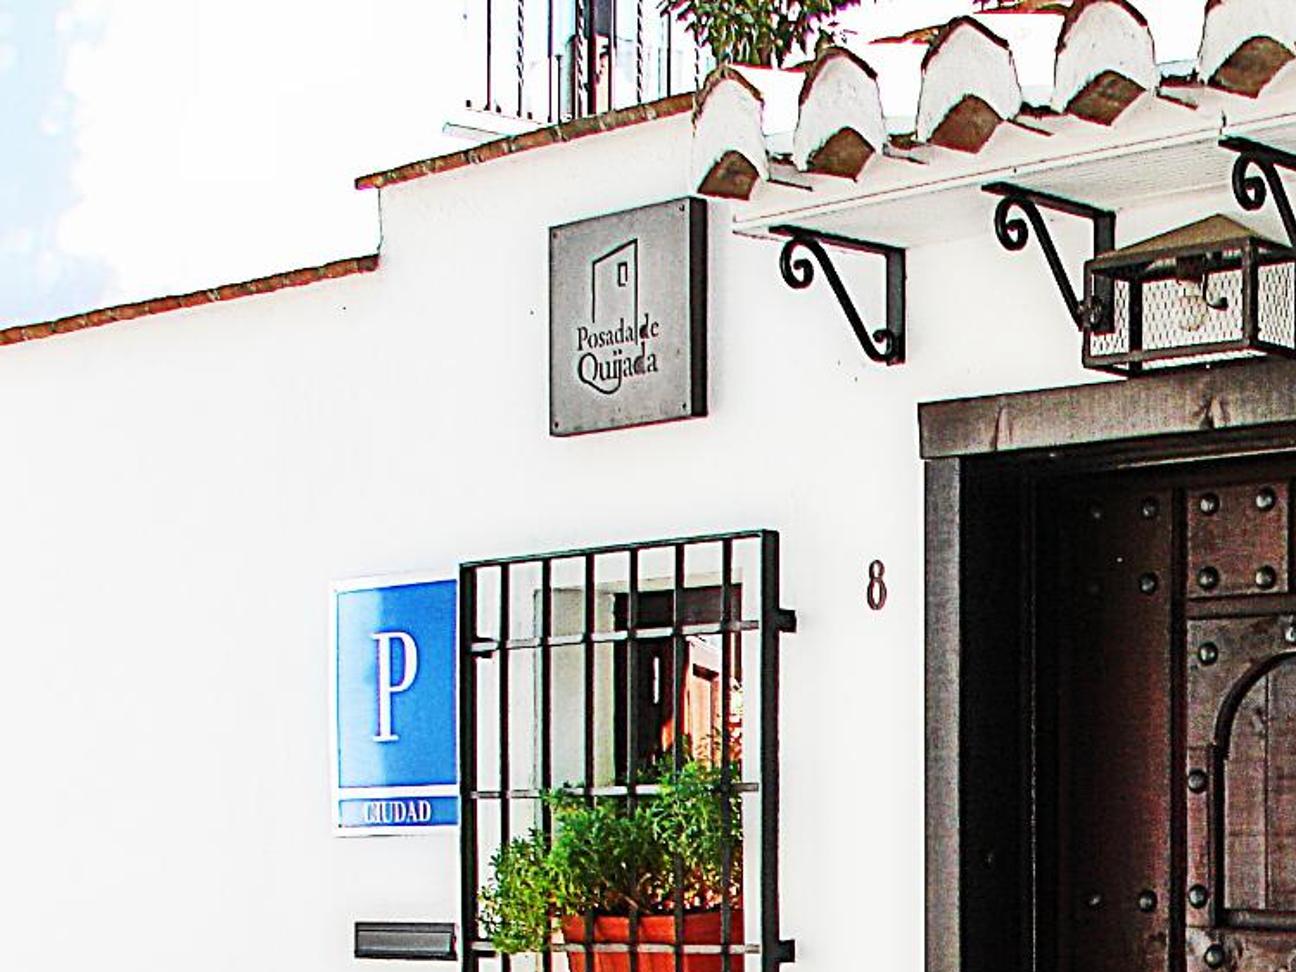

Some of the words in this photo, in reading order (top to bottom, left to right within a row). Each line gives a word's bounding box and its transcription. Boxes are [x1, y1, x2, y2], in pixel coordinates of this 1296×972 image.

[577, 317, 633, 351] Posada
[639, 312, 659, 339] de
[577, 341, 659, 395] Quijada
[867, 559, 887, 611] 8
[371, 631, 418, 742] P
[364, 800, 432, 824] CIUDAD
